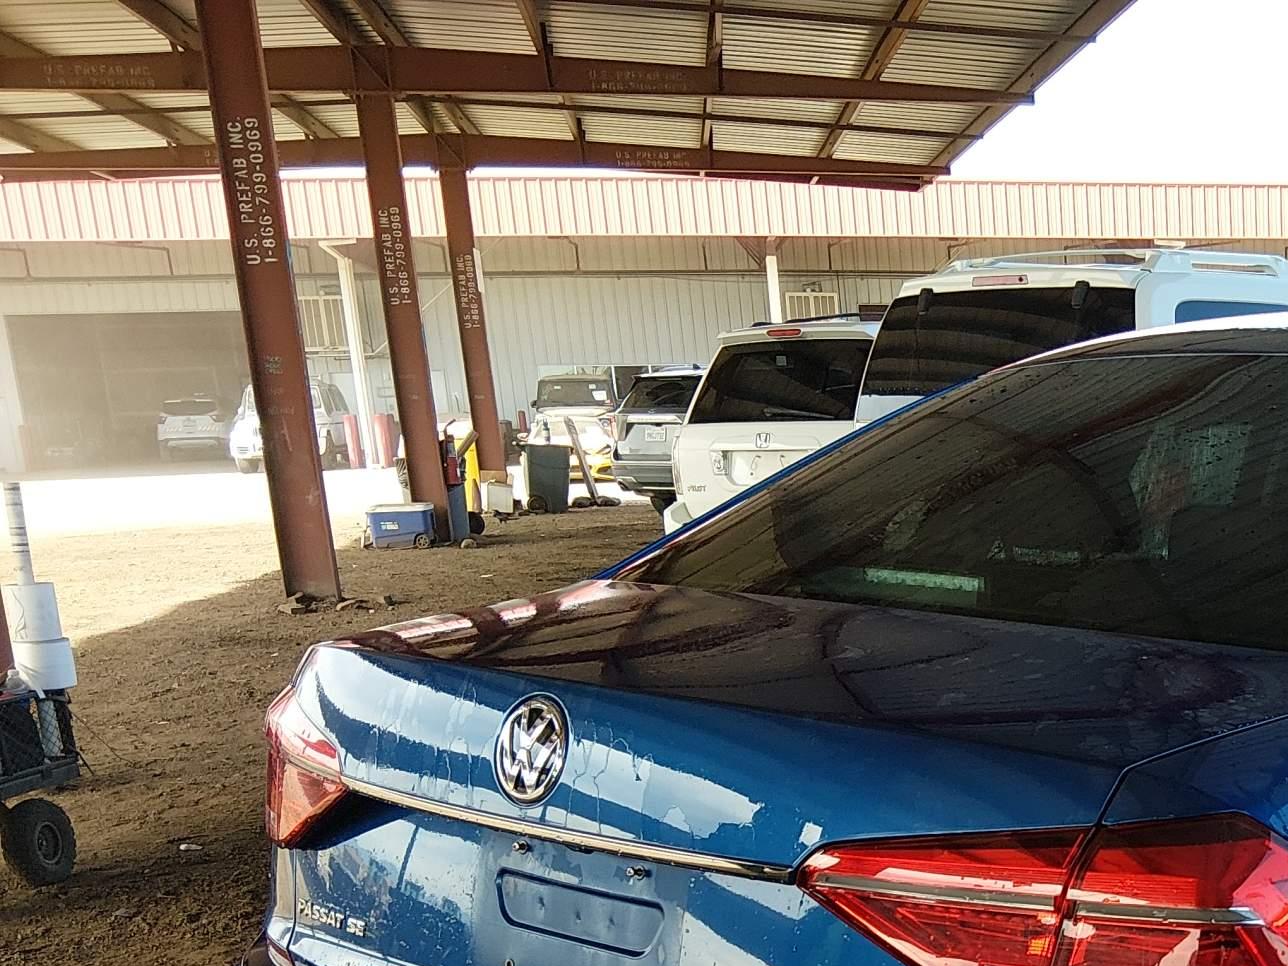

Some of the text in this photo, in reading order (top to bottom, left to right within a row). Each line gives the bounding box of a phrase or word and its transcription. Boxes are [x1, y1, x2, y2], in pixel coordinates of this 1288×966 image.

[227, 116, 261, 265] U.S. PREFAB INC.
[244, 117, 278, 263] 1-866-799-0969
[381, 233, 397, 278] PREFAB
[389, 207, 412, 304] 1-866-799-0969
[388, 283, 400, 305] U.S.
[457, 274, 469, 308] PREFAB
[298, 898, 366, 937] PASSAT SE
